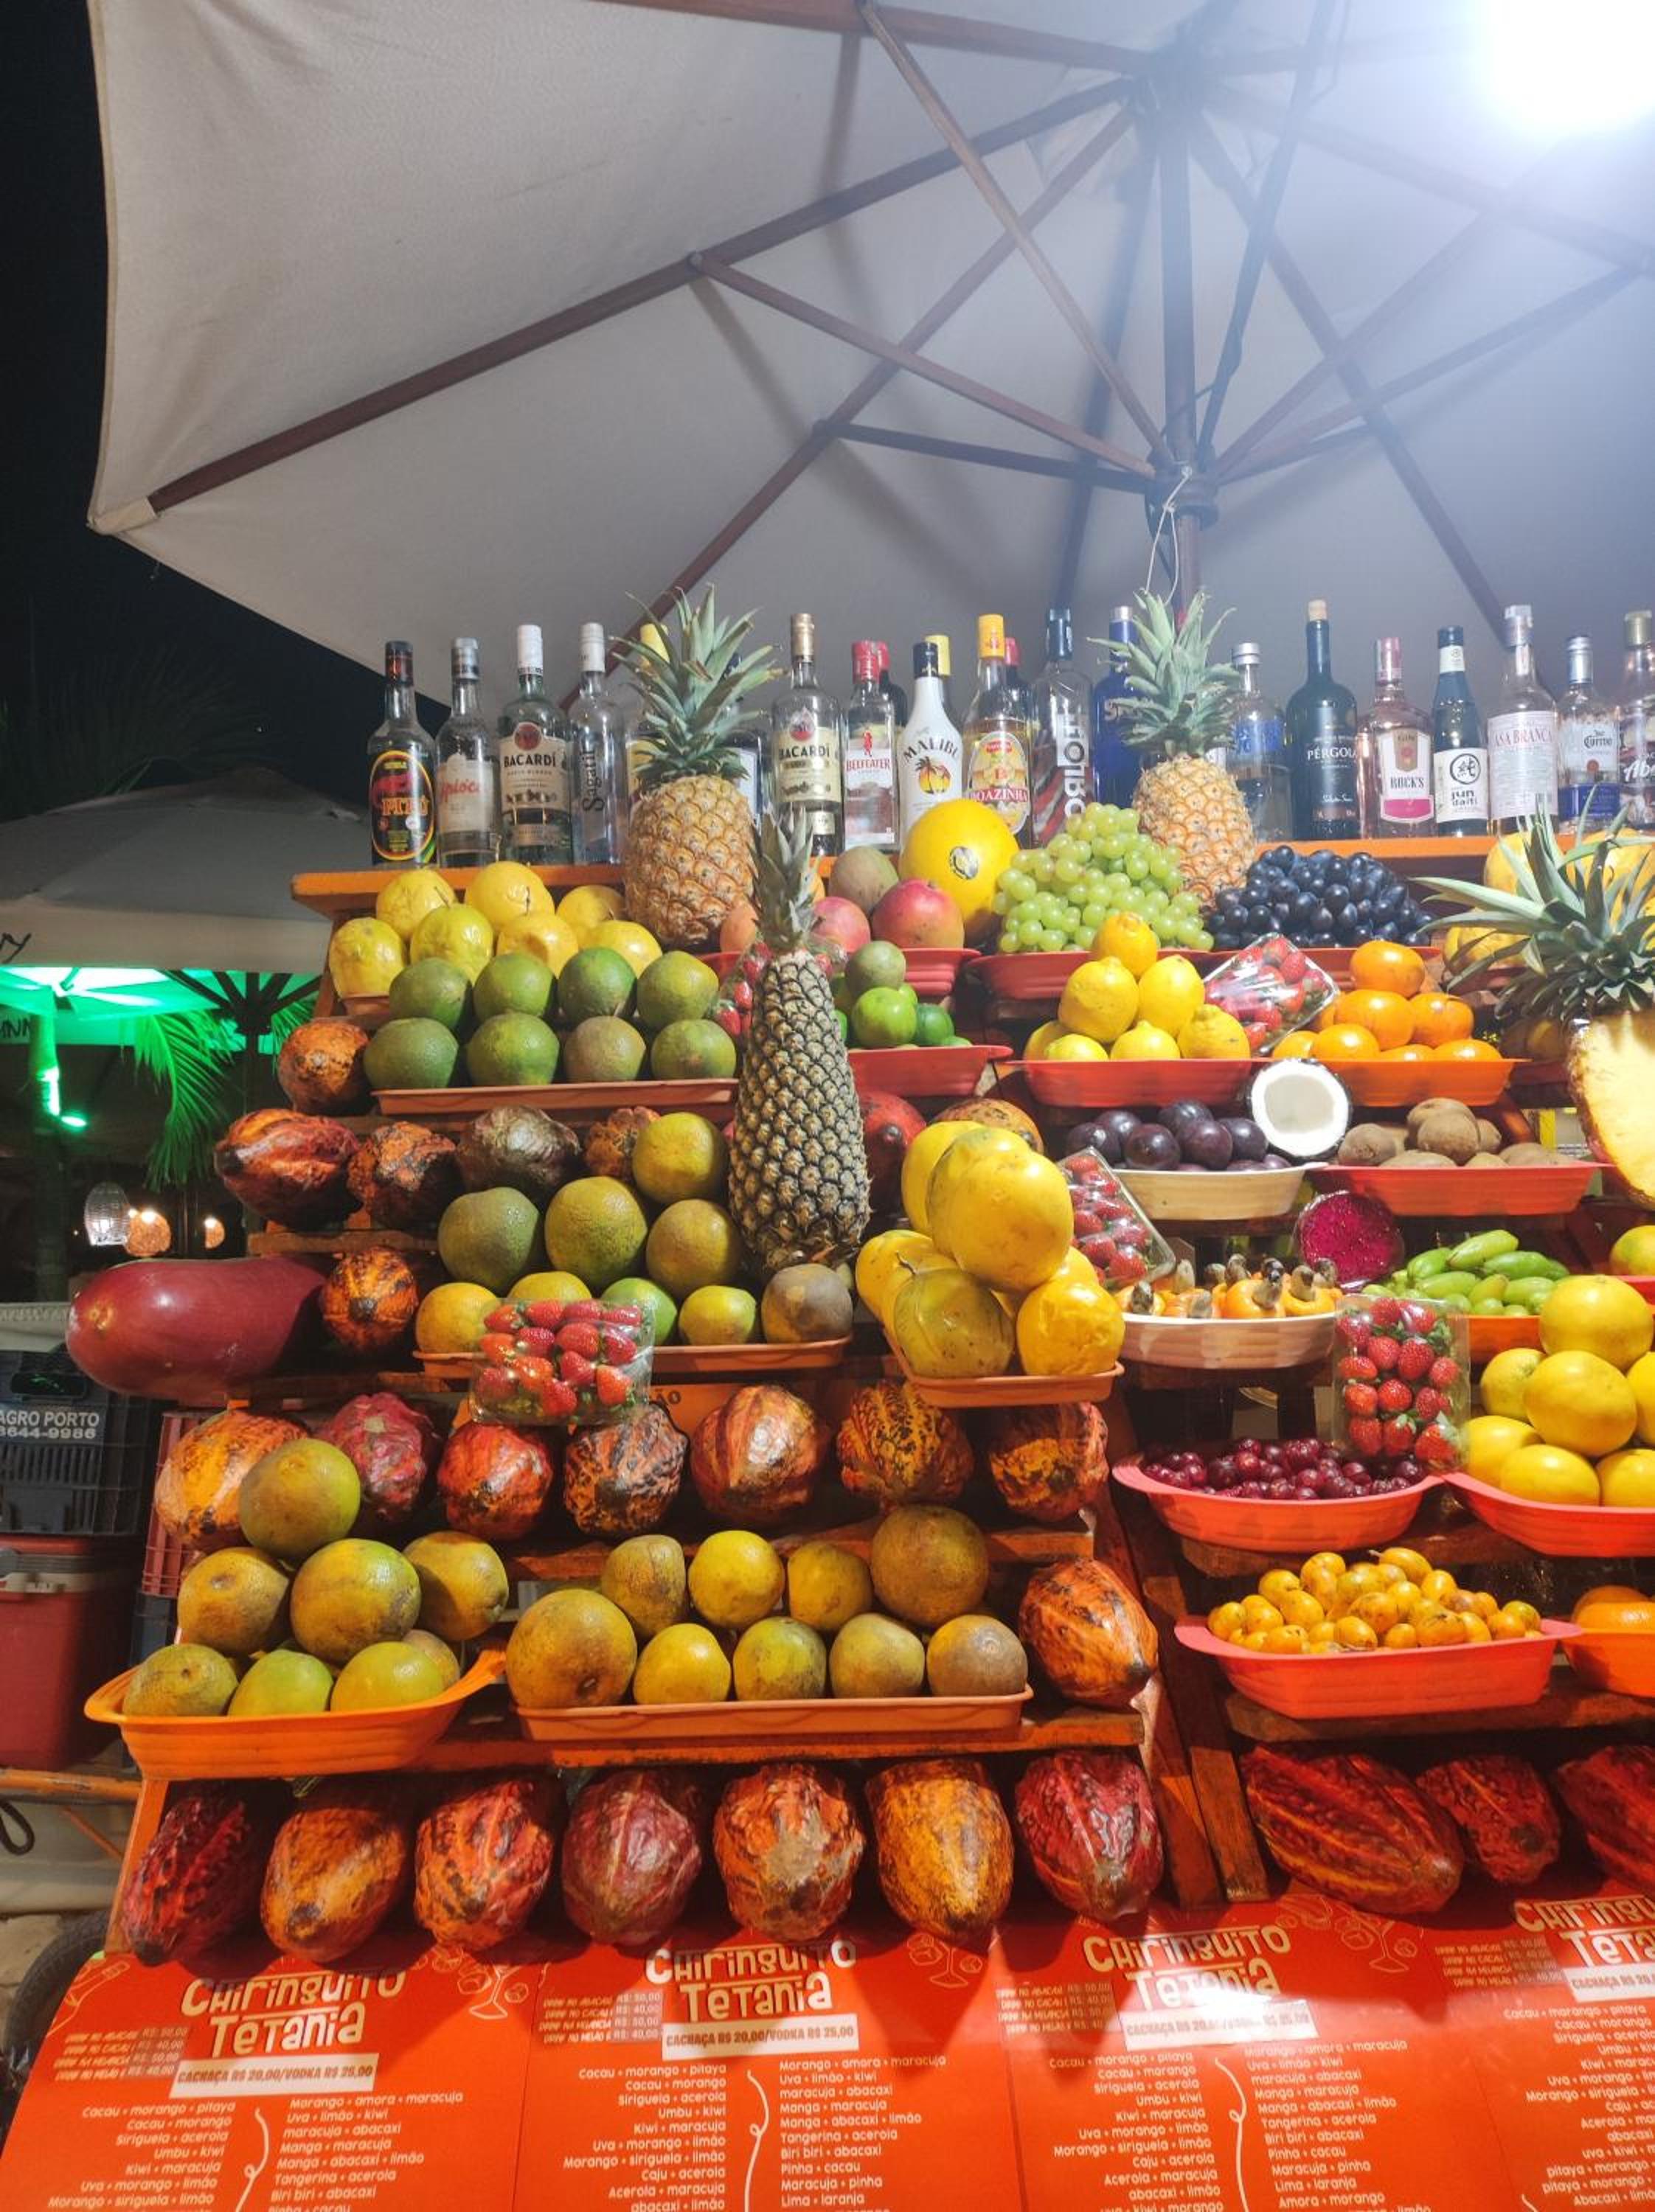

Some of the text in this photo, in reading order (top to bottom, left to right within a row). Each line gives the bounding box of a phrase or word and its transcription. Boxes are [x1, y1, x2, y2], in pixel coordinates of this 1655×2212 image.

[846, 759, 890, 771] BEEFEATER
[44, 1411, 100, 1427] PORTO
[666, 2032, 715, 2048] CACHAÇA
[824, 2026, 854, 2039] 25,00
[780, 2054, 948, 2070] Morango amora maracuja
[178, 2068, 229, 2086] CACHAÇA
[625, 2066, 679, 2077] morango
[690, 2063, 726, 2076] pitaya
[854, 2070, 876, 2081] kiwi
[673, 2079, 726, 2089] morango
[780, 2084, 893, 2098] maracuja abacaxi
[291, 2091, 463, 2108] Morango amora maracuja
[681, 2090, 726, 2102] acerola
[130, 2104, 187, 2115] morango
[196, 2101, 236, 2114] pitaya
[364, 2108, 388, 2118] kiwi
[702, 2104, 726, 2115] kiwi
[780, 2099, 887, 2114] Manga maracuja
[1258, 2102, 1297, 2114] Manga
[1308, 2098, 1354, 2110] abacaxi
[176, 2117, 232, 2128] morango
[634, 2121, 726, 2134] Kiwi maracuja
[780, 2117, 820, 2129] Manga
[831, 2114, 878, 2125] abacaxi
[1262, 2112, 1376, 2129] Tangerina acerola
[181, 2130, 229, 2141] acerola
[283, 2123, 401, 2138] maracuja abacaxi
[781, 2128, 898, 2143] Tangerina acerola
[1112, 2125, 1165, 2136] morango
[1264, 2129, 1364, 2143] Biri biri abacaxi
[200, 2145, 225, 2155] kiwi
[281, 2138, 391, 2154] Manga maracuja
[626, 2138, 682, 2149] morango
[780, 2144, 881, 2157] Biri biri abacaxi
[1055, 2144, 1106, 2155] Morango
[1118, 2139, 1168, 2152] siriguela
[1167, 2153, 1215, 2164] acerola
[1269, 2147, 1346, 2158] Pinha cacau
[277, 2157, 319, 2169] Manga
[330, 2154, 379, 2166] abacaxi
[563, 2156, 618, 2168] Morango
[629, 2152, 682, 2166] siriguela
[781, 2162, 860, 2172] Pinha cacau
[125, 2161, 222, 2174] Kiwi maracuja
[679, 2166, 726, 2177] acerola
[1271, 2160, 1371, 2175] Maracuja pinha
[275, 2169, 396, 2185] Tangerina acerola
[1104, 2168, 1218, 2183] Acerola maracuja
[114, 2180, 173, 2191] morango
[608, 2183, 726, 2197] Acerola maracuja
[782, 2176, 882, 2190] Maracuja pinha
[1274, 2177, 1357, 2191] Lima laranja
[271, 2186, 376, 2199] Biri biri abacaxi
[782, 2193, 864, 2205] Lima laranja
[1128, 2187, 1177, 2198] abacaxi
[49, 2197, 104, 2208] Morango
[115, 2194, 169, 2207] siriguela
[631, 2200, 679, 2211] abacaxi
[1279, 2194, 1385, 2206] Amora morango
